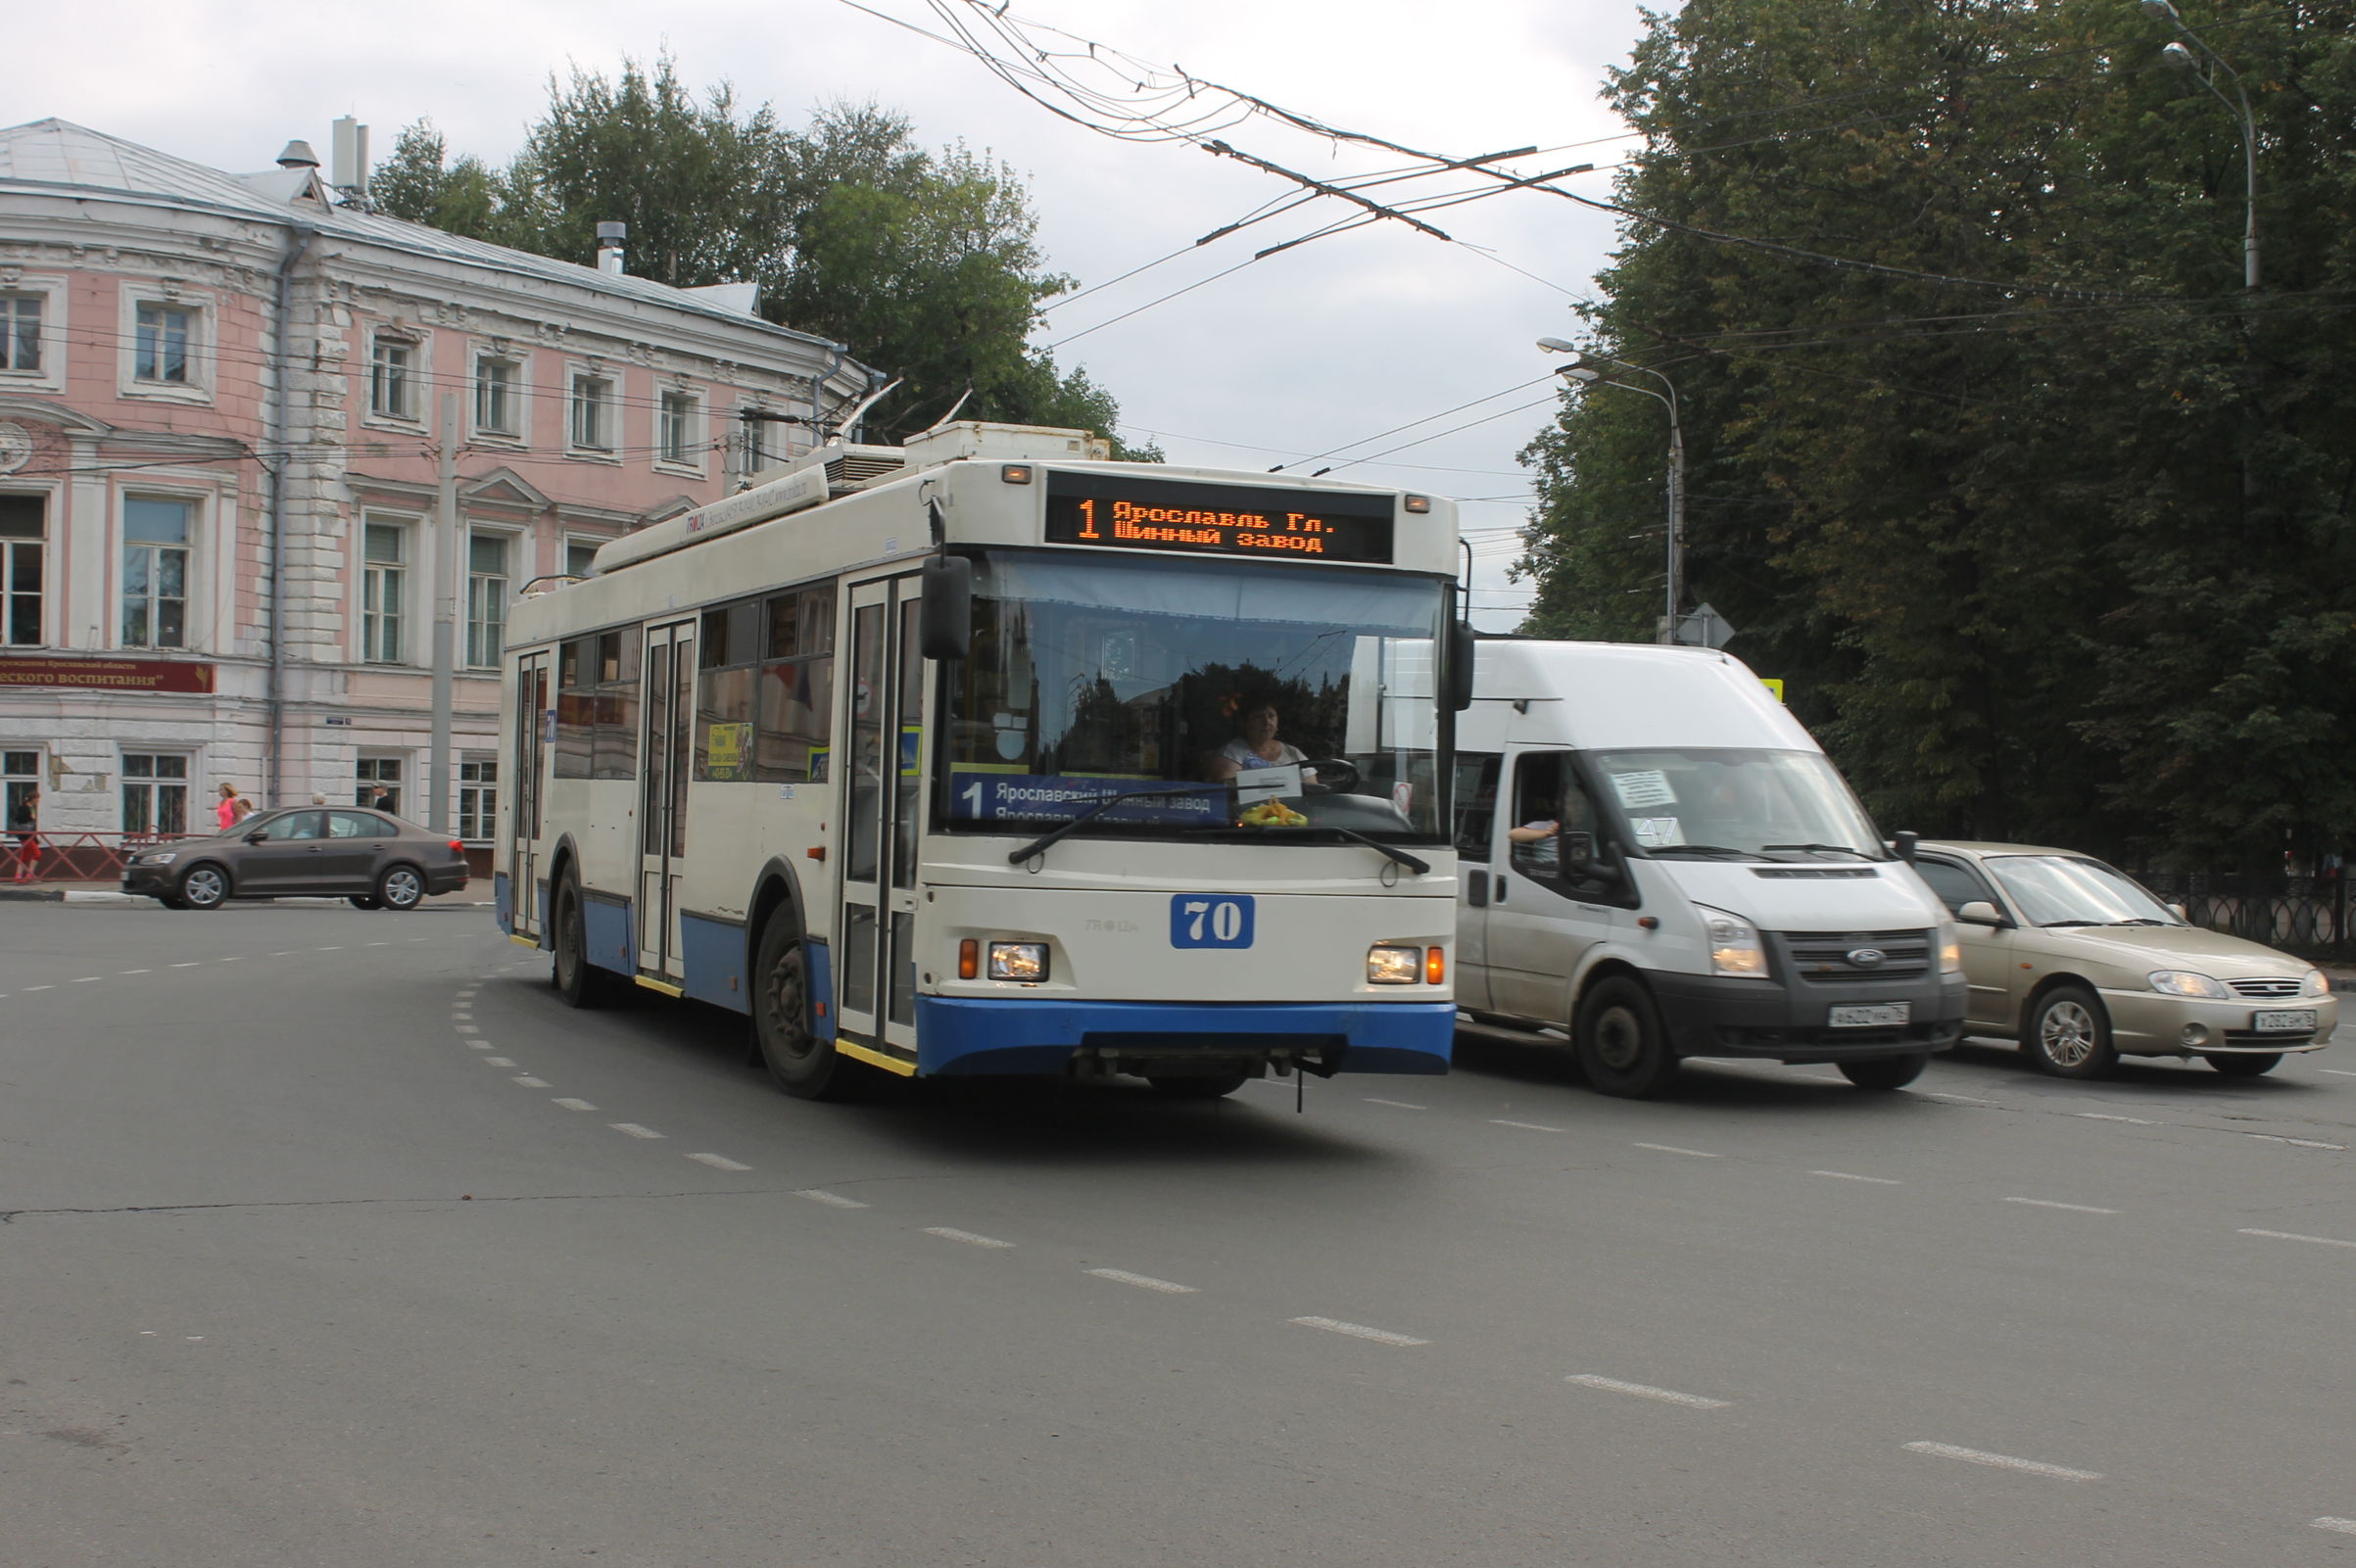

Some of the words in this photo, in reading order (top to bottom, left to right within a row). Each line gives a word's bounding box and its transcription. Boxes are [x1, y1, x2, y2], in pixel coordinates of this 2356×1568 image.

[1079, 499, 1099, 539] 1
[1113, 500, 1270, 529] Ярославль
[1285, 512, 1334, 534] Гл.
[1115, 520, 1221, 545] Шинный
[1236, 533, 1323, 553] завод
[58, 674, 165, 686] воспитания"
[962, 782, 983, 821] 1
[995, 782, 1098, 805] Ярославский
[1169, 796, 1211, 814] завод
[1635, 817, 1678, 846] 47
[1183, 901, 1242, 941] 70
